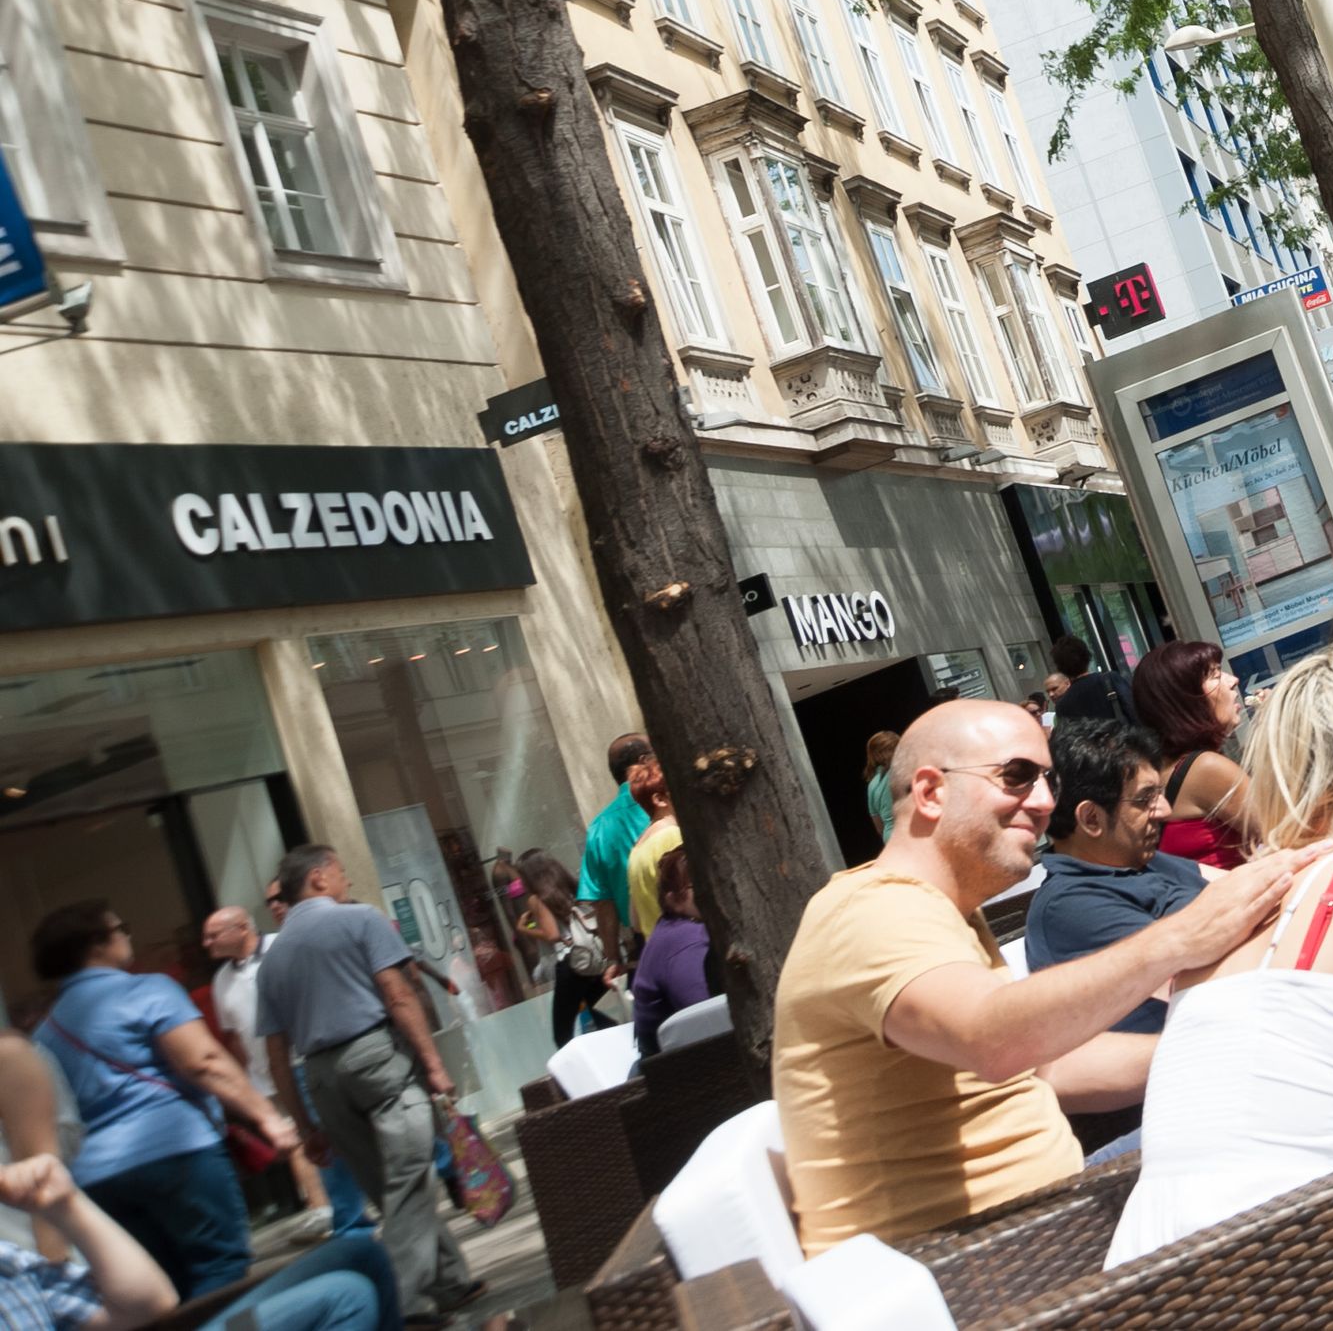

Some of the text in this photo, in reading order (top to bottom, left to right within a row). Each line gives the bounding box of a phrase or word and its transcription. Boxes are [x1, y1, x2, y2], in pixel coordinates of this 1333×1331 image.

[1240, 288, 1266, 305] MIA
[1266, 269, 1318, 294] CUCINA
[1171, 437, 1283, 494] Küchen/Möbel
[171, 489, 495, 557] CALZEDONIA
[784, 590, 896, 647] MANGO
[1284, 599, 1306, 612] Möbel
[1305, 587, 1333, 604] Museum
